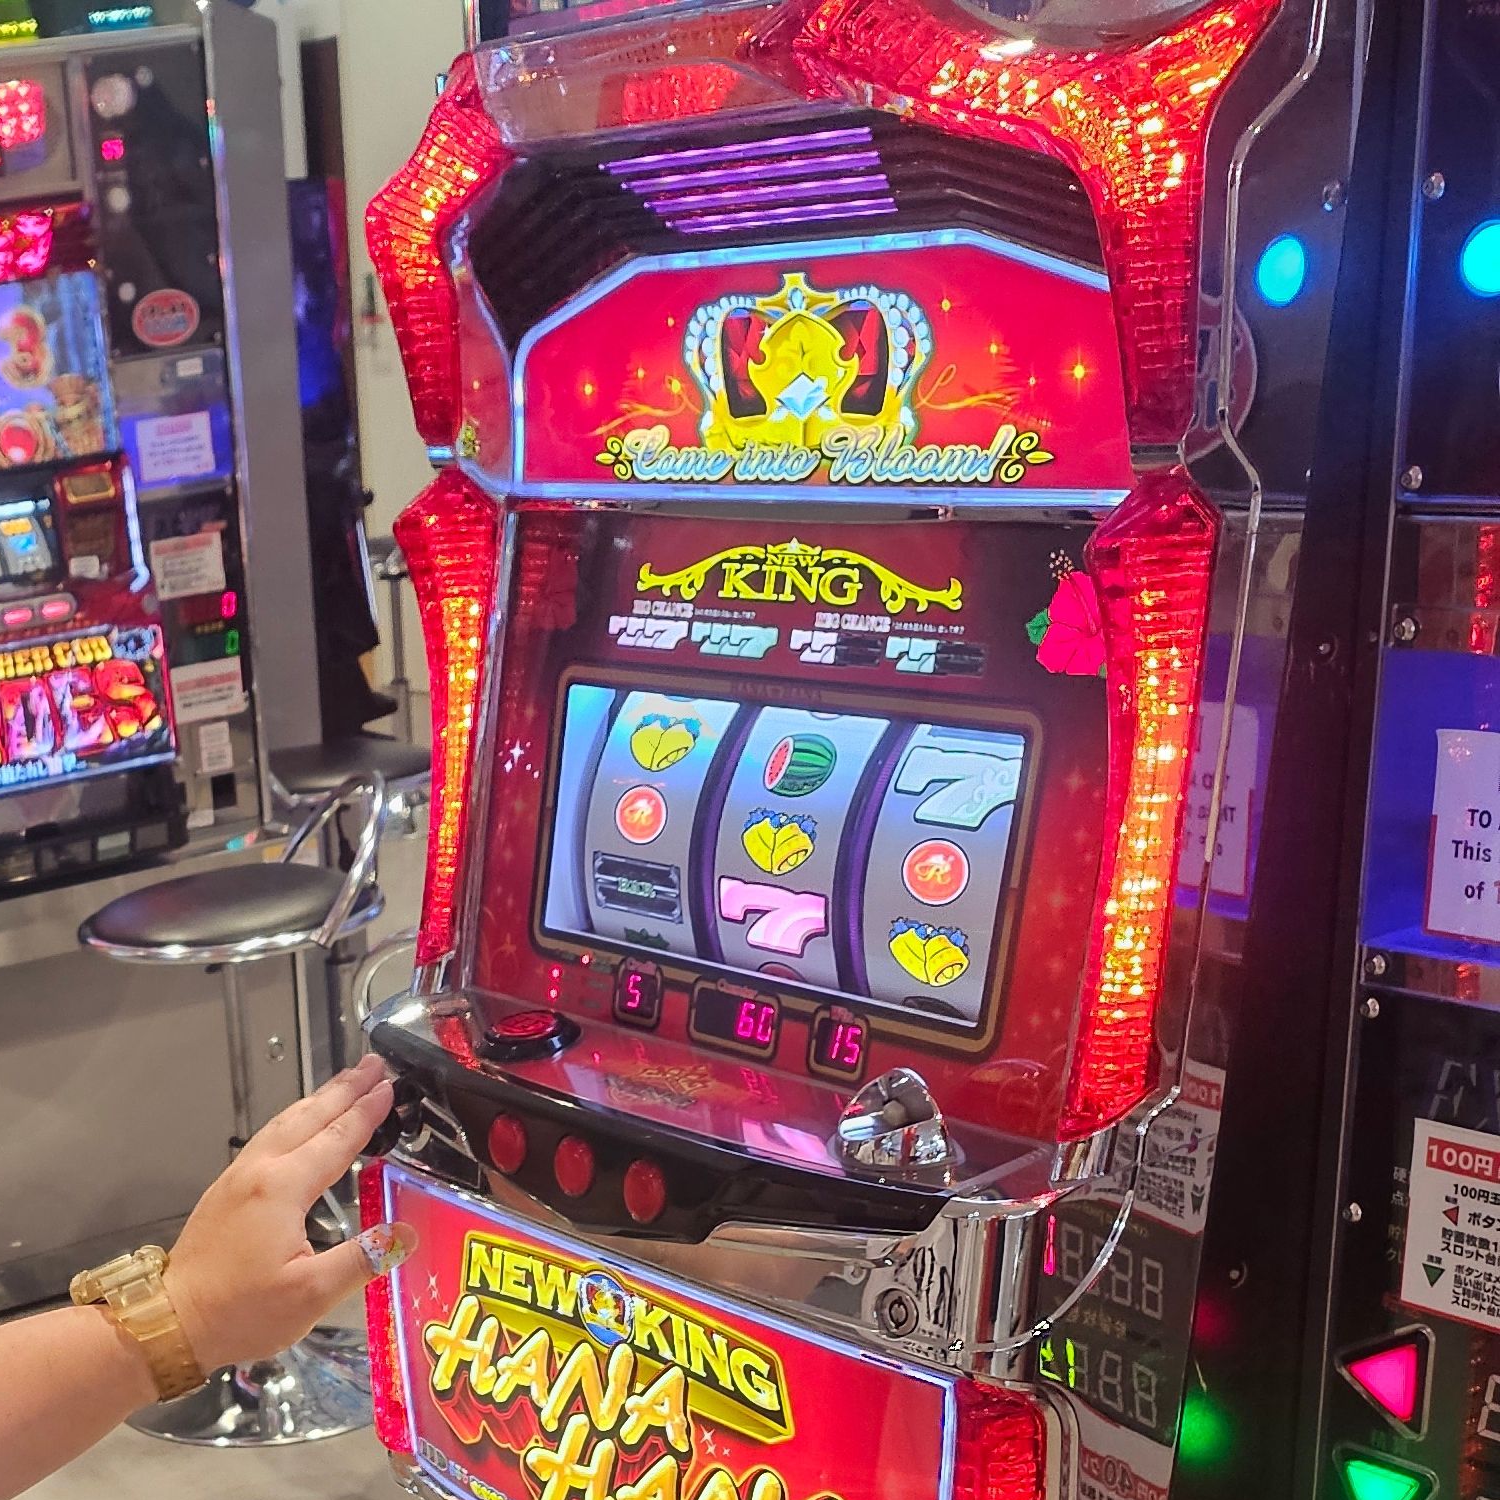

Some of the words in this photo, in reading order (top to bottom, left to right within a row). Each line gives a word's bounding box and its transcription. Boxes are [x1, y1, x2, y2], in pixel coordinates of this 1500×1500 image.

[625, 424, 735, 481] Come
[734, 441, 820, 482] into
[821, 423, 1018, 484] Bloom!
[765, 553, 821, 568] NEW
[717, 562, 863, 606] KING
[1467, 808, 1492, 829] TO
[1452, 839, 1492, 863] This
[1464, 881, 1485, 900] of
[718, 876, 828, 957] 7
[626, 973, 642, 1009] 5
[737, 1001, 775, 1044] 60
[830, 1024, 862, 1064] 15
[467, 1241, 586, 1317] NEW
[630, 1295, 781, 1412] KING
[1451, 1297, 1500, 1318] スロット台
[424, 1295, 691, 1454] HANA
